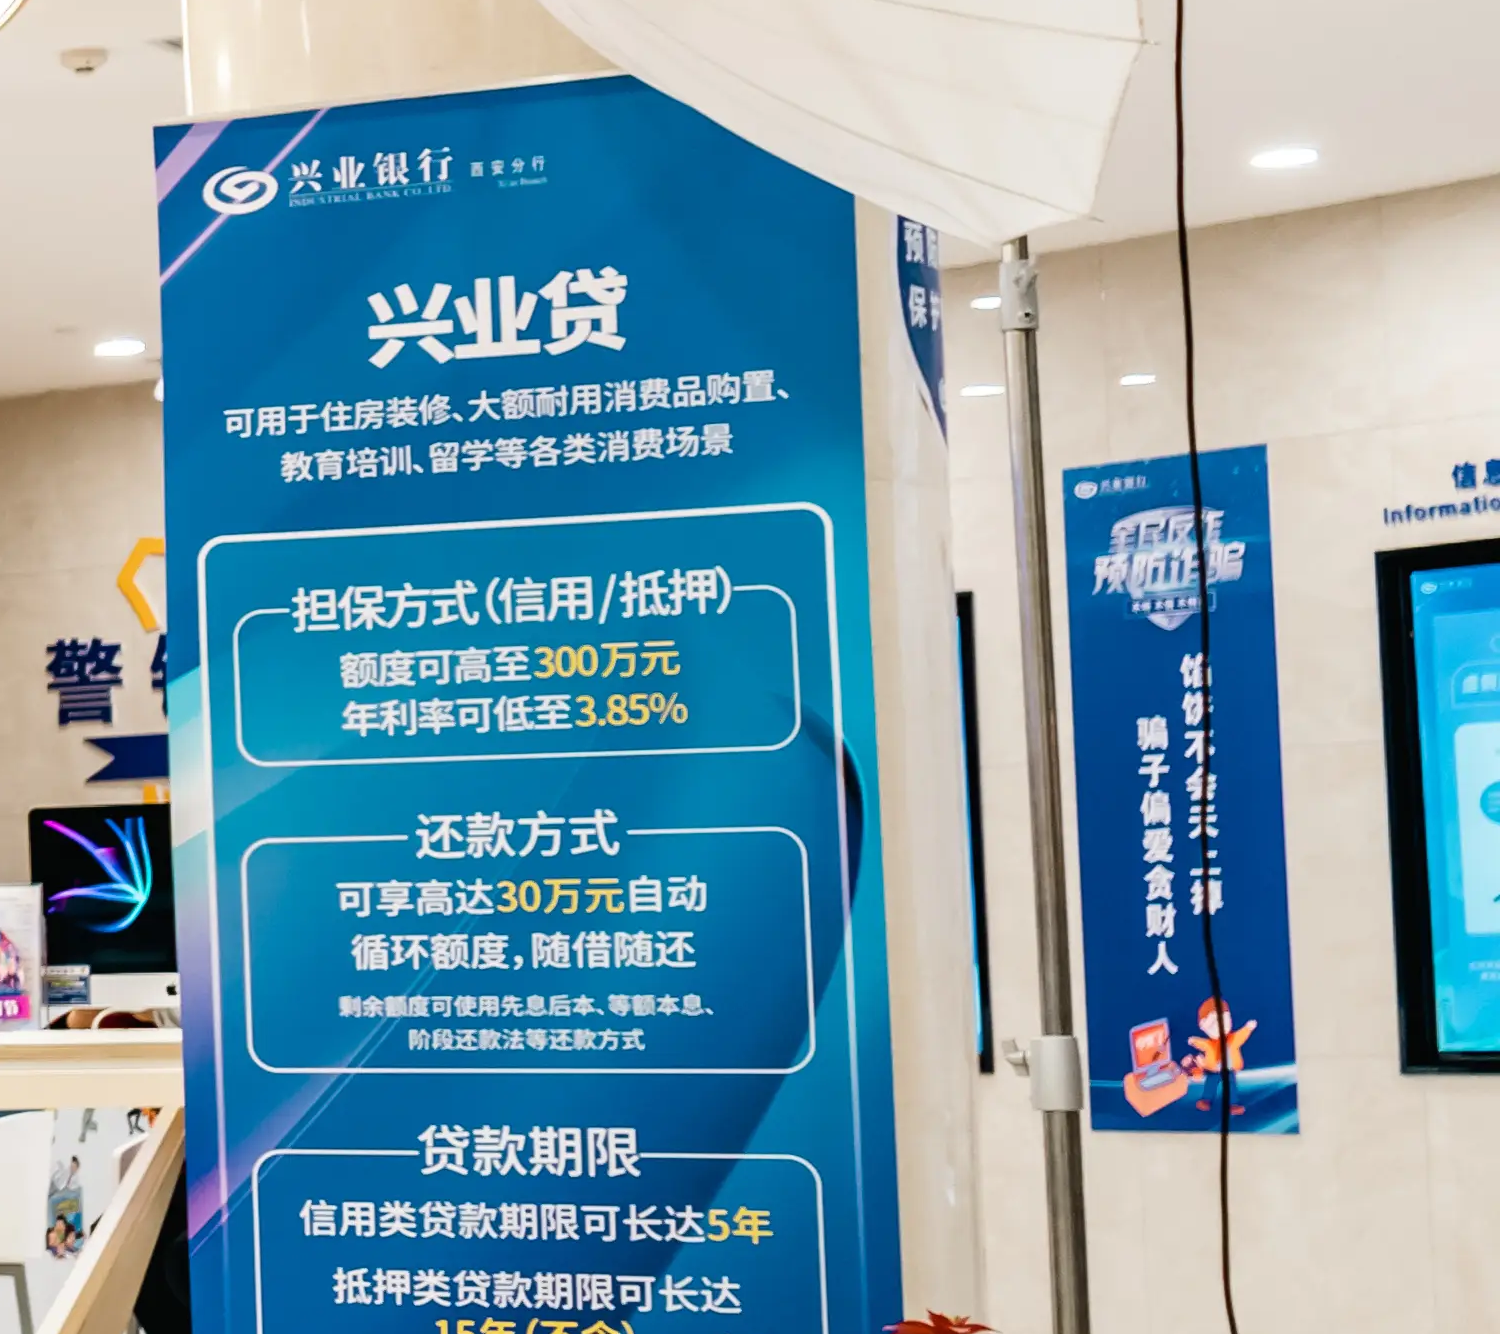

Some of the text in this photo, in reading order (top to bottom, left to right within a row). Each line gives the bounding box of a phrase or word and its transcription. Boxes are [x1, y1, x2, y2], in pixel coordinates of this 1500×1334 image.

[289, 146, 453, 194] 兴业银行
[367, 266, 628, 369] 兴业贷
[339, 639, 681, 689] 额度可高至300万元
[341, 692, 689, 737] 年利率可低至3.85%
[415, 809, 620, 860] 还款方式
[1136, 714, 1179, 975] 骗子偏爱贪财人
[335, 874, 708, 918] 可享高达30万元自动
[408, 1028, 646, 1052] 阶段还款法等还款方式
[417, 1124, 646, 1178] 贷款期限
[299, 1199, 774, 1245] 信用类贷款期限可长达5年
[332, 1266, 742, 1315] 抵押类贷款期限可长达
